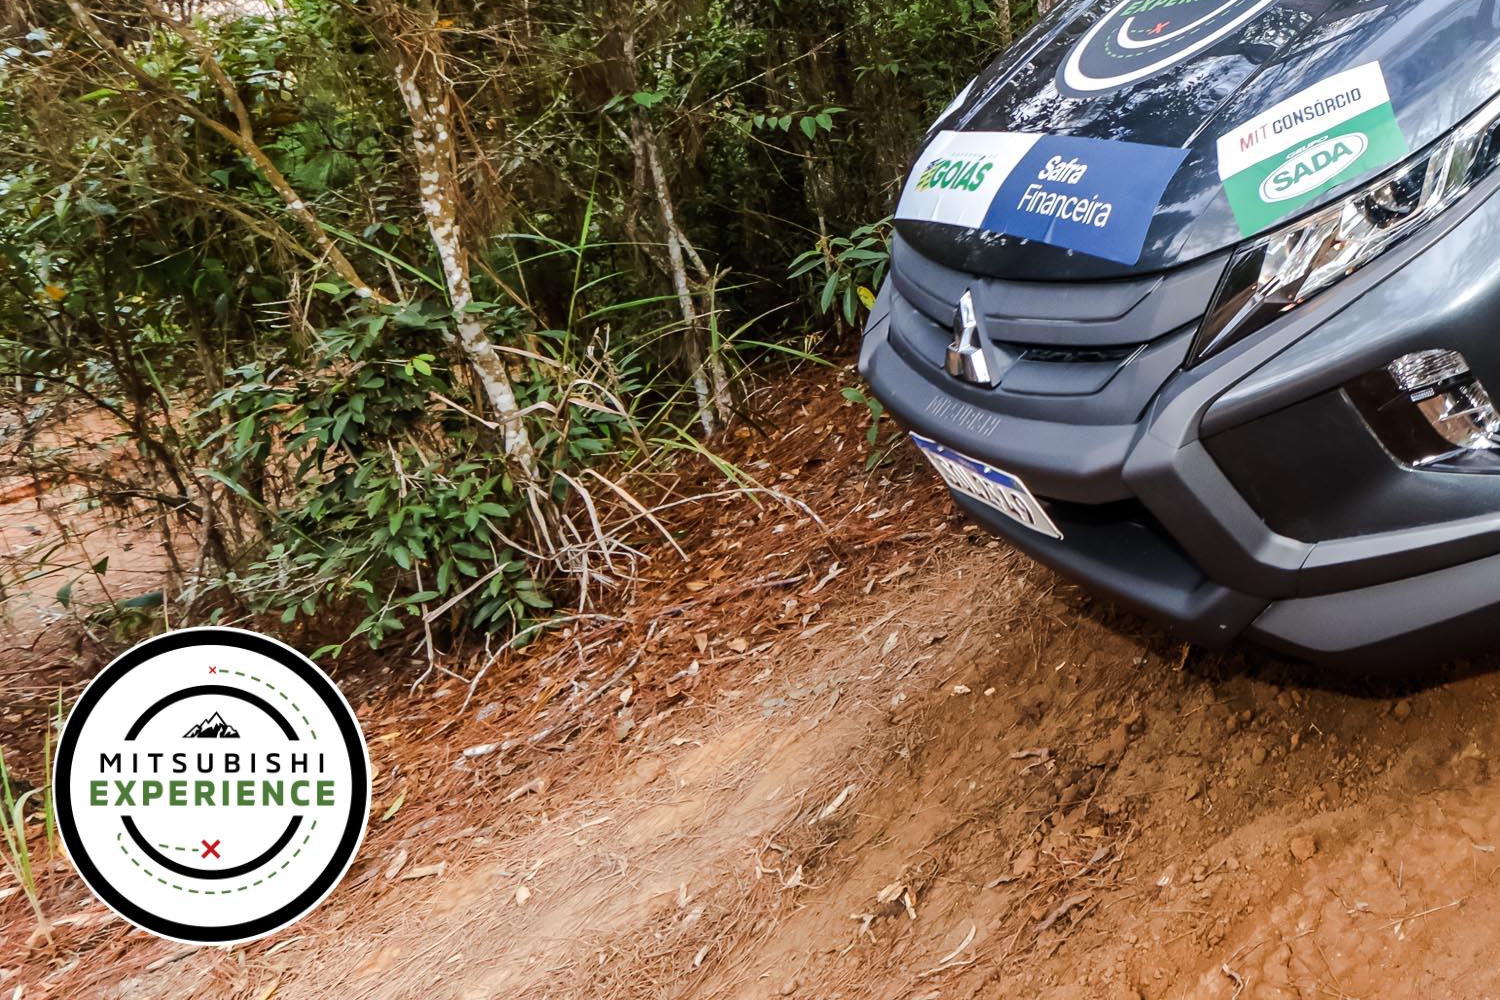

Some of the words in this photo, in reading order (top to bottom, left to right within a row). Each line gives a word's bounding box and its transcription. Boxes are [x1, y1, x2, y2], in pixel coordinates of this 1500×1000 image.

[1239, 124, 1268, 152] MIT
[1271, 87, 1363, 134] CONSÓRCIO
[930, 155, 994, 192] GOIÁS
[1038, 155, 1088, 184] Safra
[1273, 141, 1354, 192] SADA
[1016, 183, 1113, 228] Financeira
